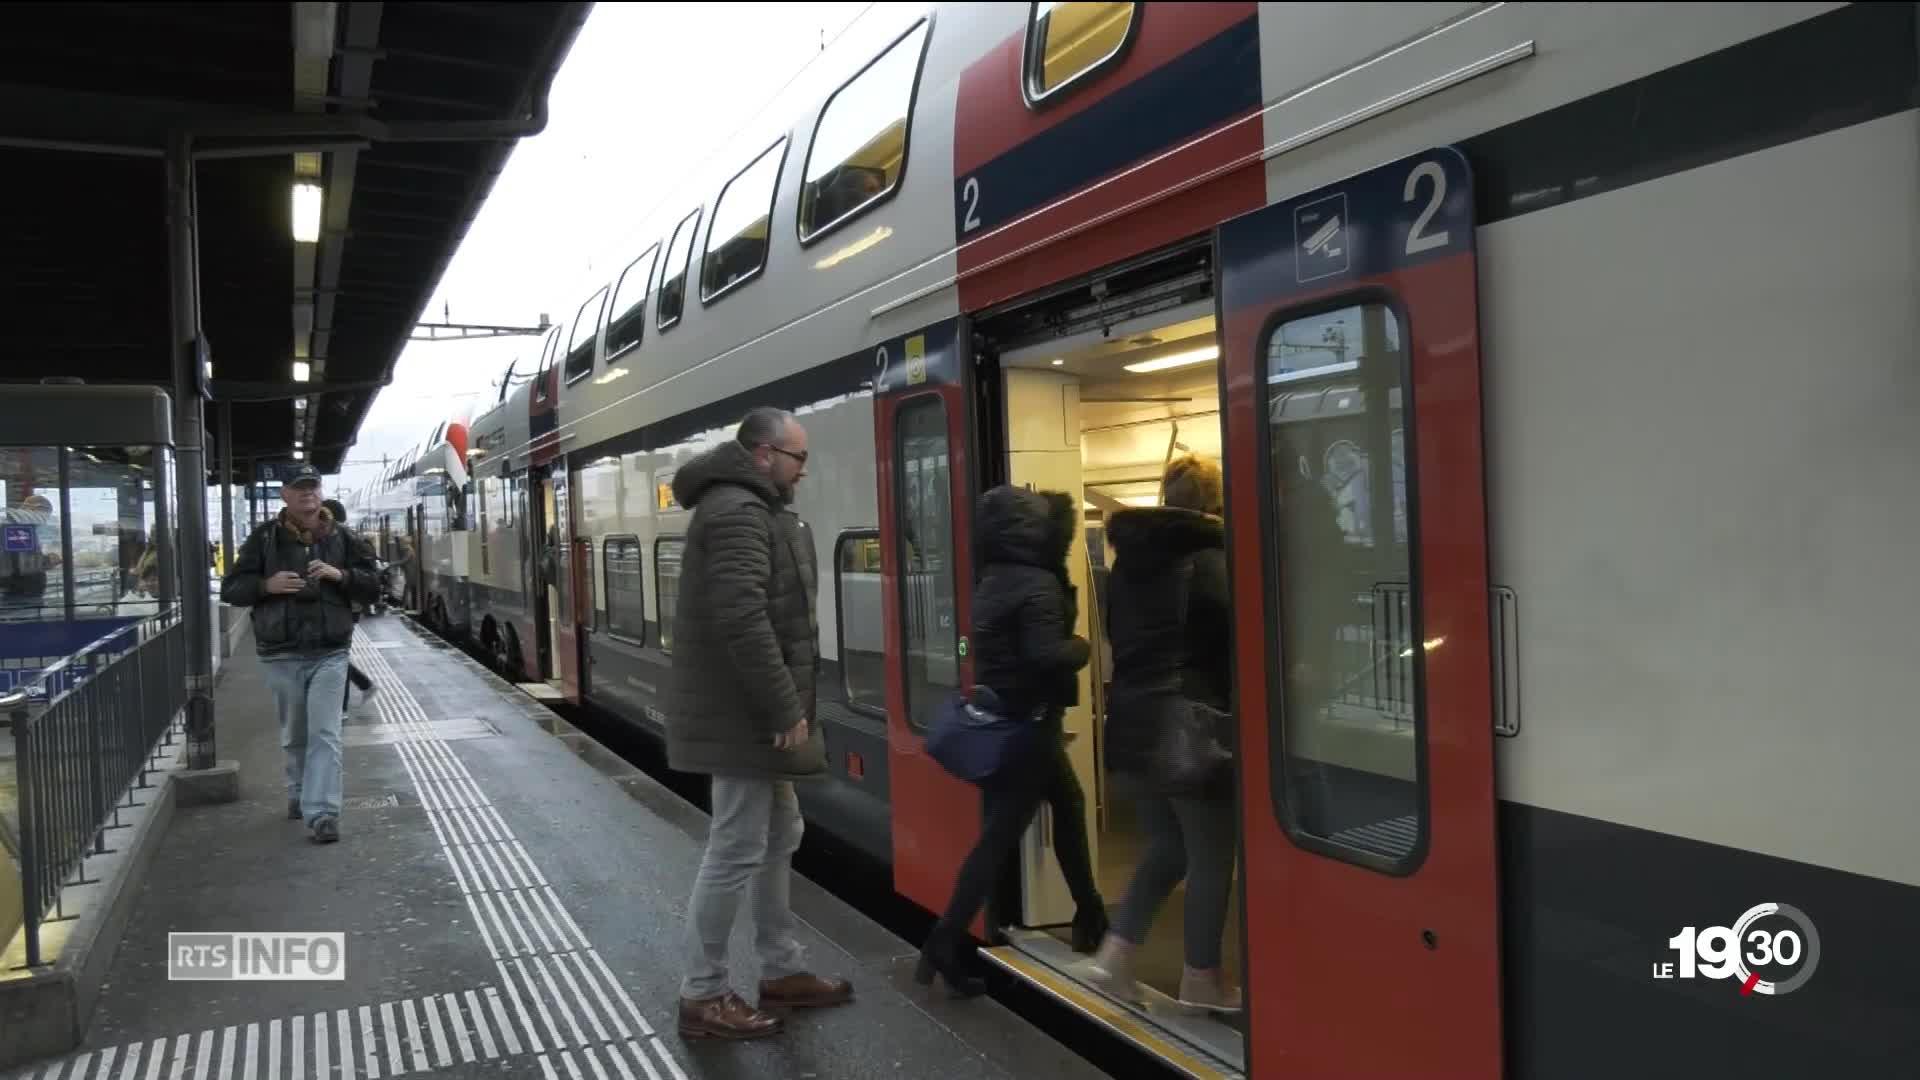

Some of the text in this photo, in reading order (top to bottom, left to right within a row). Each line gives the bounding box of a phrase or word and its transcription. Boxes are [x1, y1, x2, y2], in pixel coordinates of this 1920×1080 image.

[963, 177, 981, 233] 2
[1403, 161, 1449, 257] 2
[876, 346, 890, 392] 2
